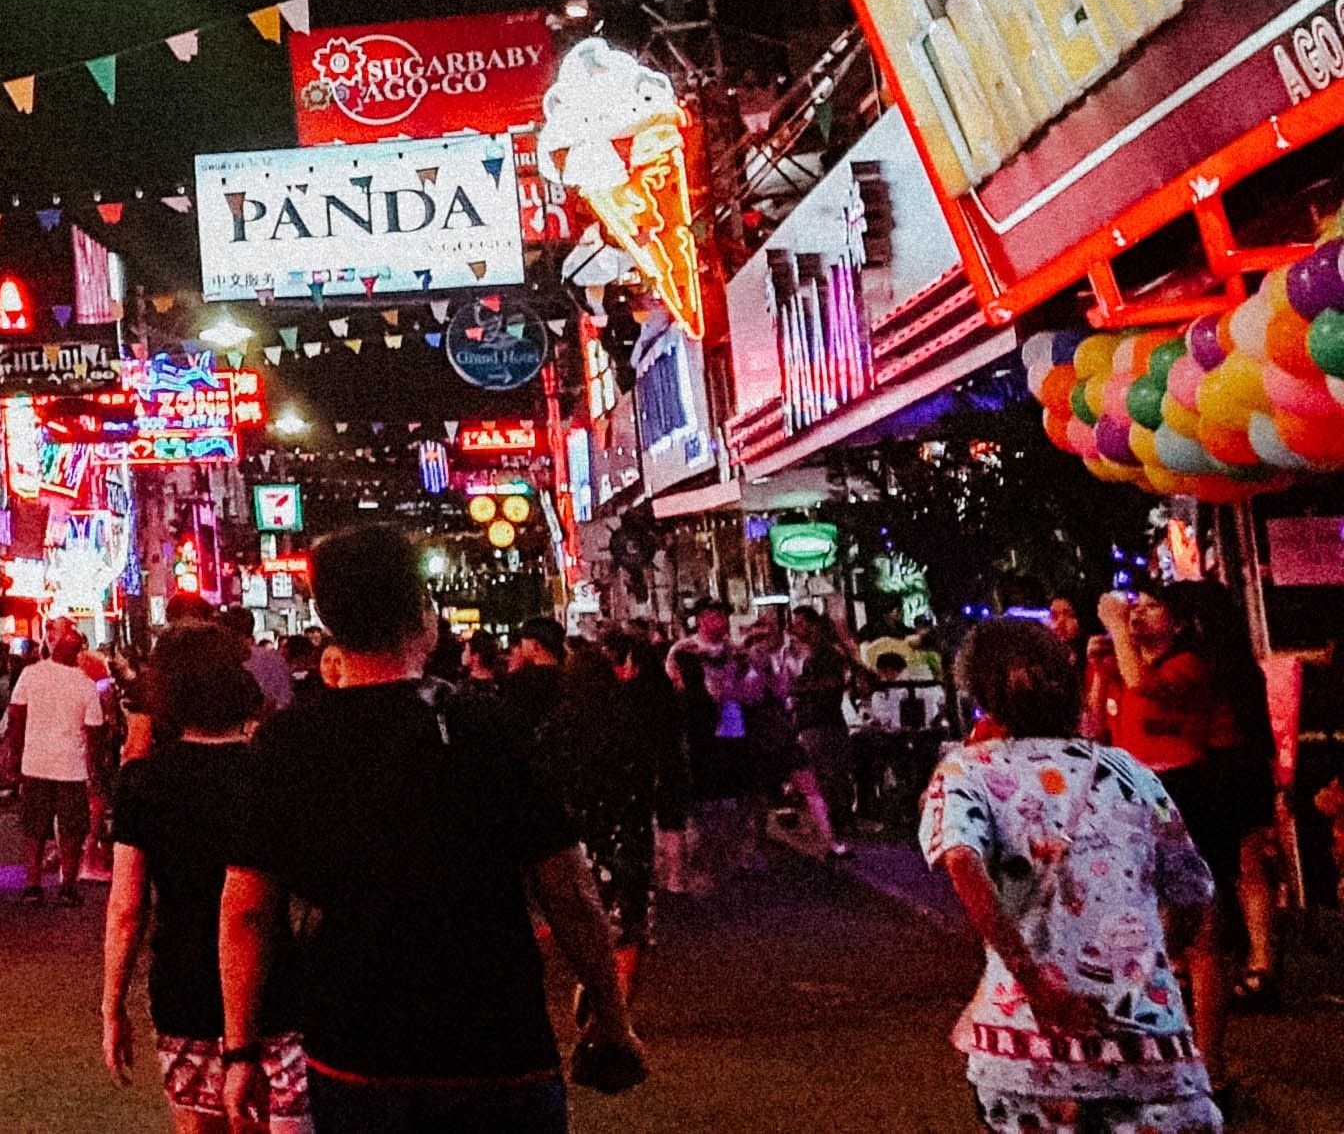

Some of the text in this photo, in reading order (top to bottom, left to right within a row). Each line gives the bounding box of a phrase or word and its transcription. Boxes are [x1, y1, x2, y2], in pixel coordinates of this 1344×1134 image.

[365, 44, 543, 83] SUGARBABY
[364, 72, 487, 104] AGO-GO
[226, 184, 487, 243] PANDA
